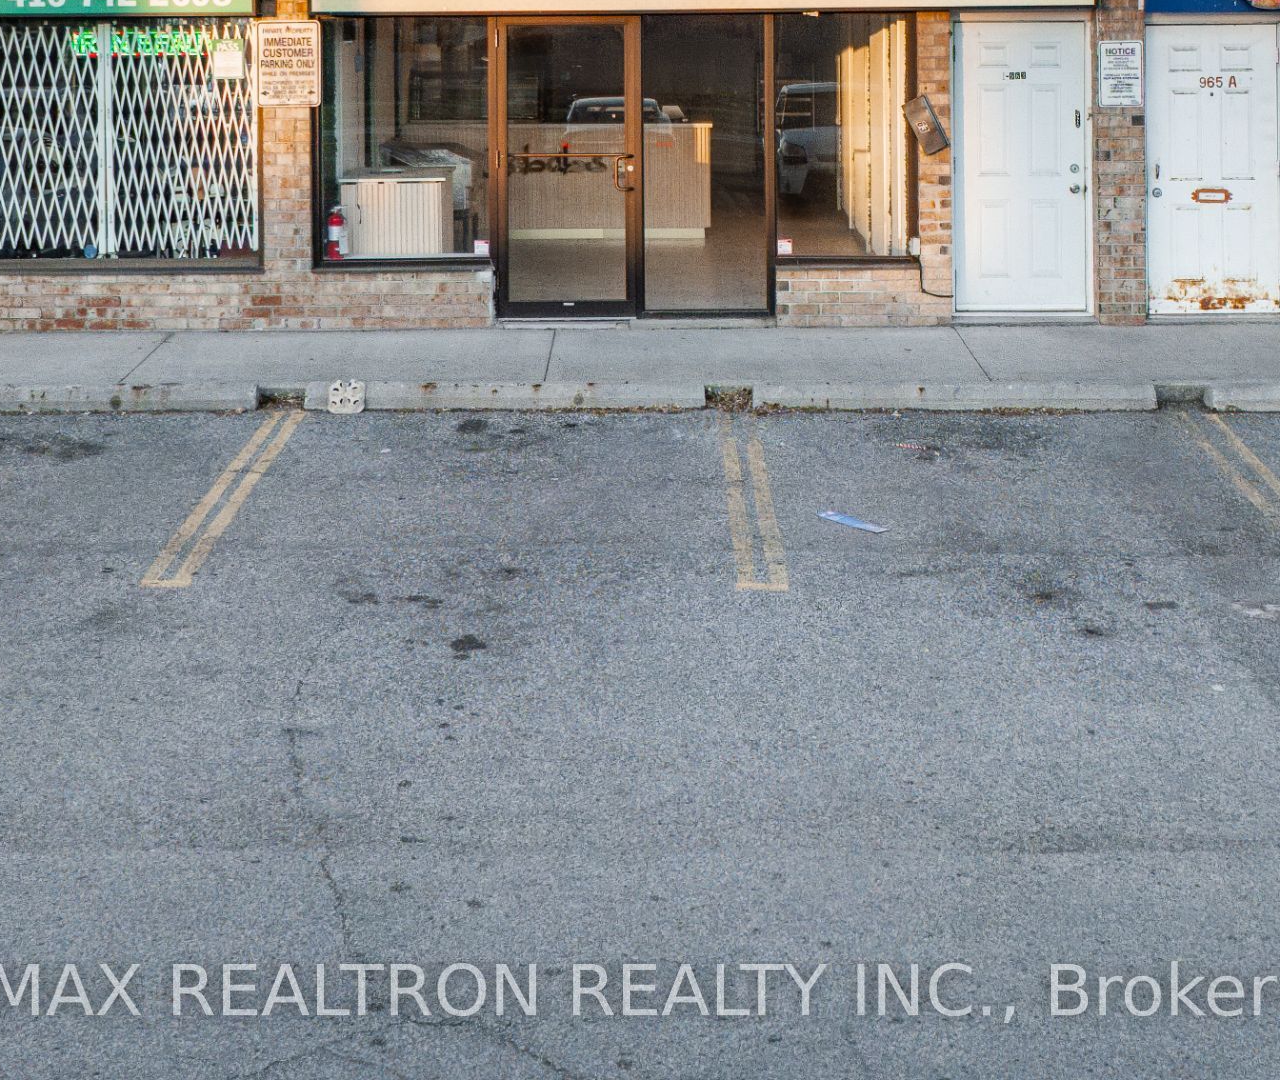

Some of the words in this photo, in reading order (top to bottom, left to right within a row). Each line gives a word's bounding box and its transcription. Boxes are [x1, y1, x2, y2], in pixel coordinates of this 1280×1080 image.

[216, 42, 239, 52] PASS
[263, 37, 312, 47] IMMEDIATE
[263, 48, 314, 58] CUSTOMER
[260, 59, 293, 69] PARKING
[296, 59, 315, 69] ONLY
[1199, 76, 1223, 88] 965
[1228, 75, 1237, 88] A
